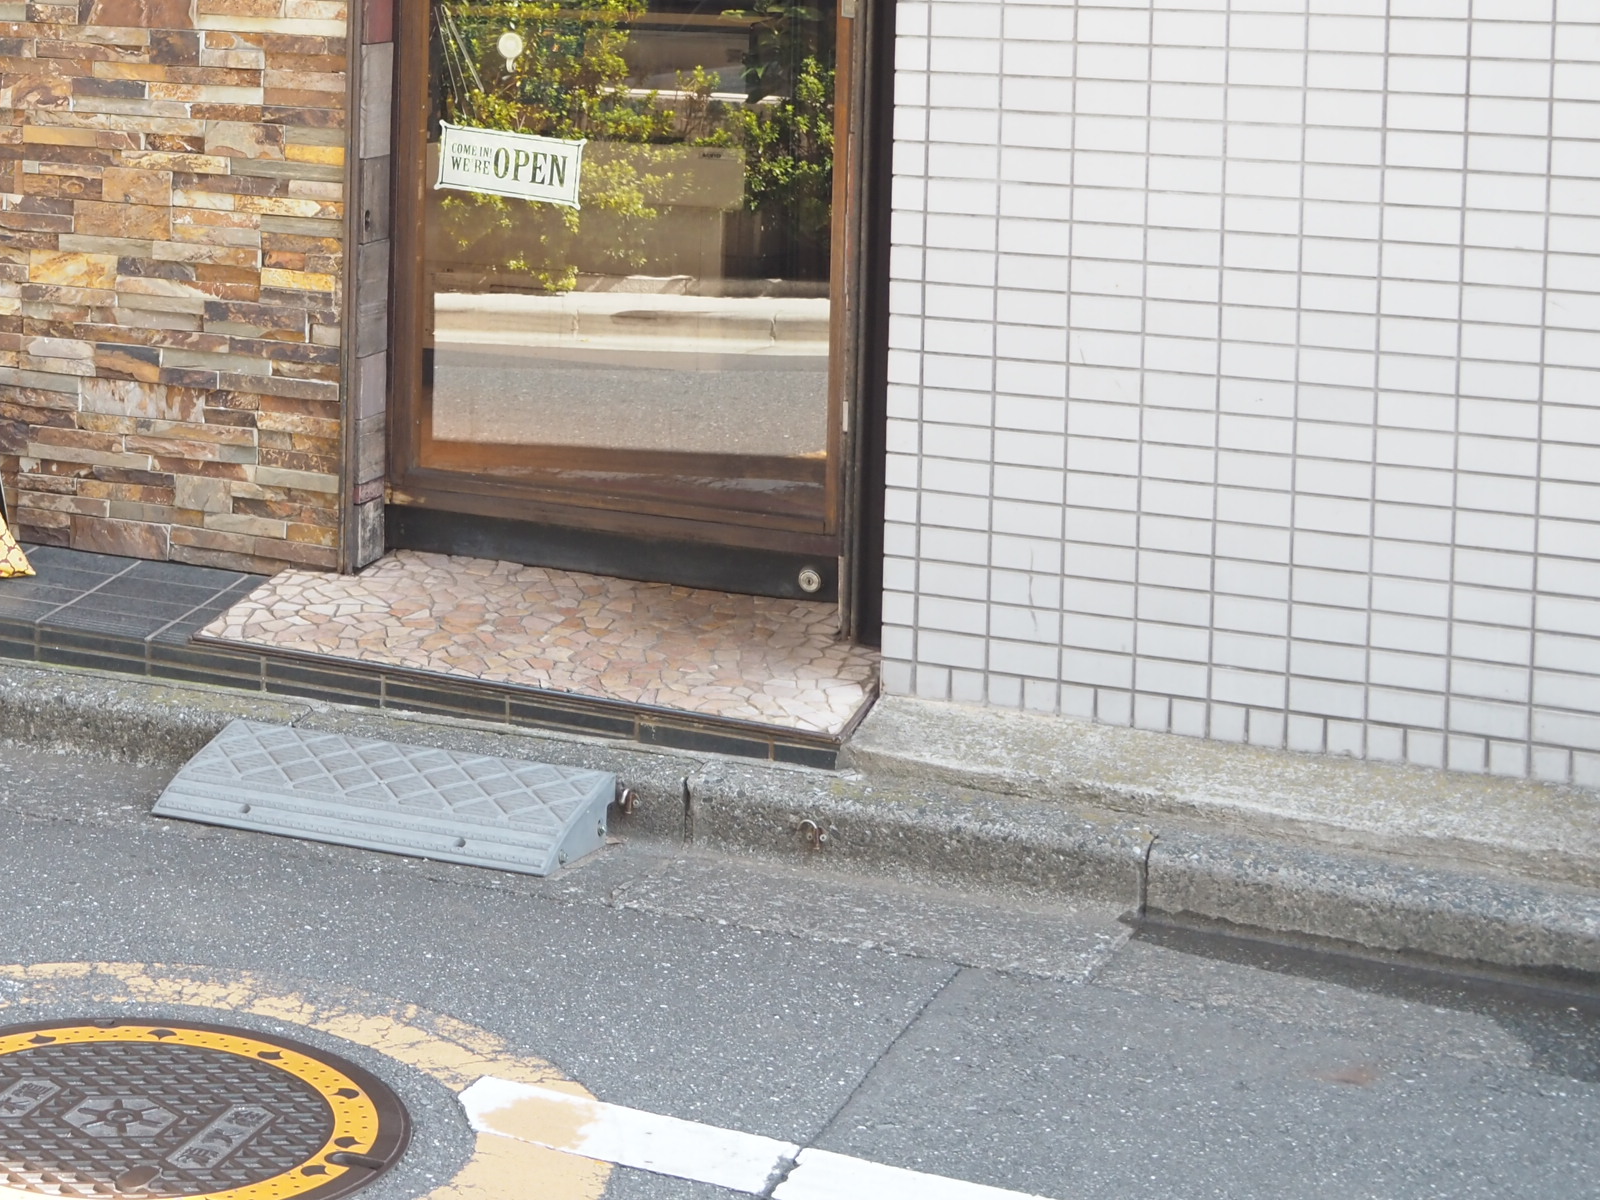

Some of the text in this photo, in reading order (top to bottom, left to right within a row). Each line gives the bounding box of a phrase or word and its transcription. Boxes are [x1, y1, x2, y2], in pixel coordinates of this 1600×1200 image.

[451, 142, 493, 159] COME IN!
[451, 155, 491, 175] WE'RE
[493, 147, 568, 188] OPEN
